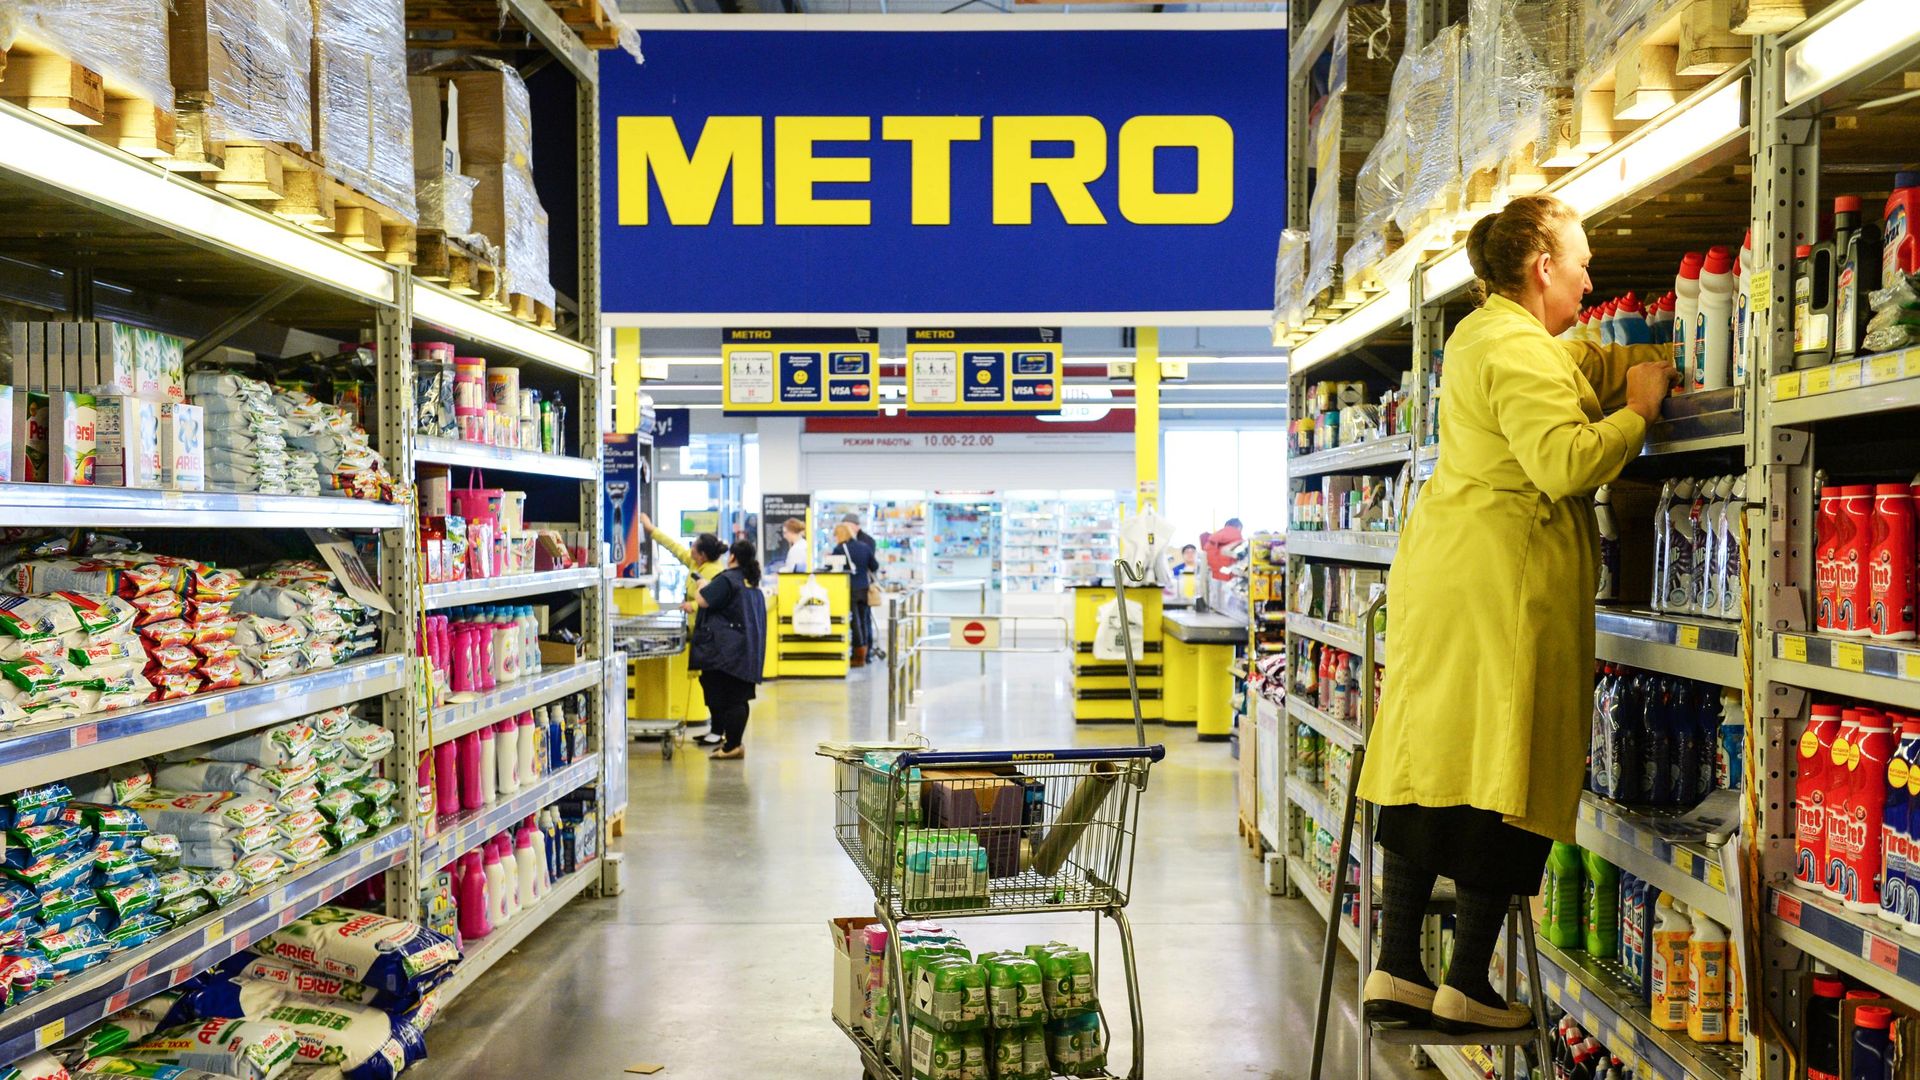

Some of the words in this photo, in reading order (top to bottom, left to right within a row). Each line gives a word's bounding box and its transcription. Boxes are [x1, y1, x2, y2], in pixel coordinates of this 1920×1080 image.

[616, 114, 1235, 226] METRO
[731, 330, 772, 339] METRO
[915, 330, 955, 339] METRO
[168, 385, 183, 398] ARIEL
[830, 387, 851, 395] VISA
[1014, 387, 1034, 395] VISA
[843, 438, 874, 447] РЕЖИМ
[876, 438, 911, 447] РАБОТЫ:
[924, 435, 994, 447] 10.00-22.00
[175, 455, 202, 471] ARIEL
[1012, 753, 1055, 761] METRO
[1796, 803, 1822, 830] Tiret
[1799, 825, 1818, 835] TURBO
[338, 914, 386, 937] ARIEL
[275, 943, 321, 966] ARIEL
[294, 976, 343, 994] ARIEL
